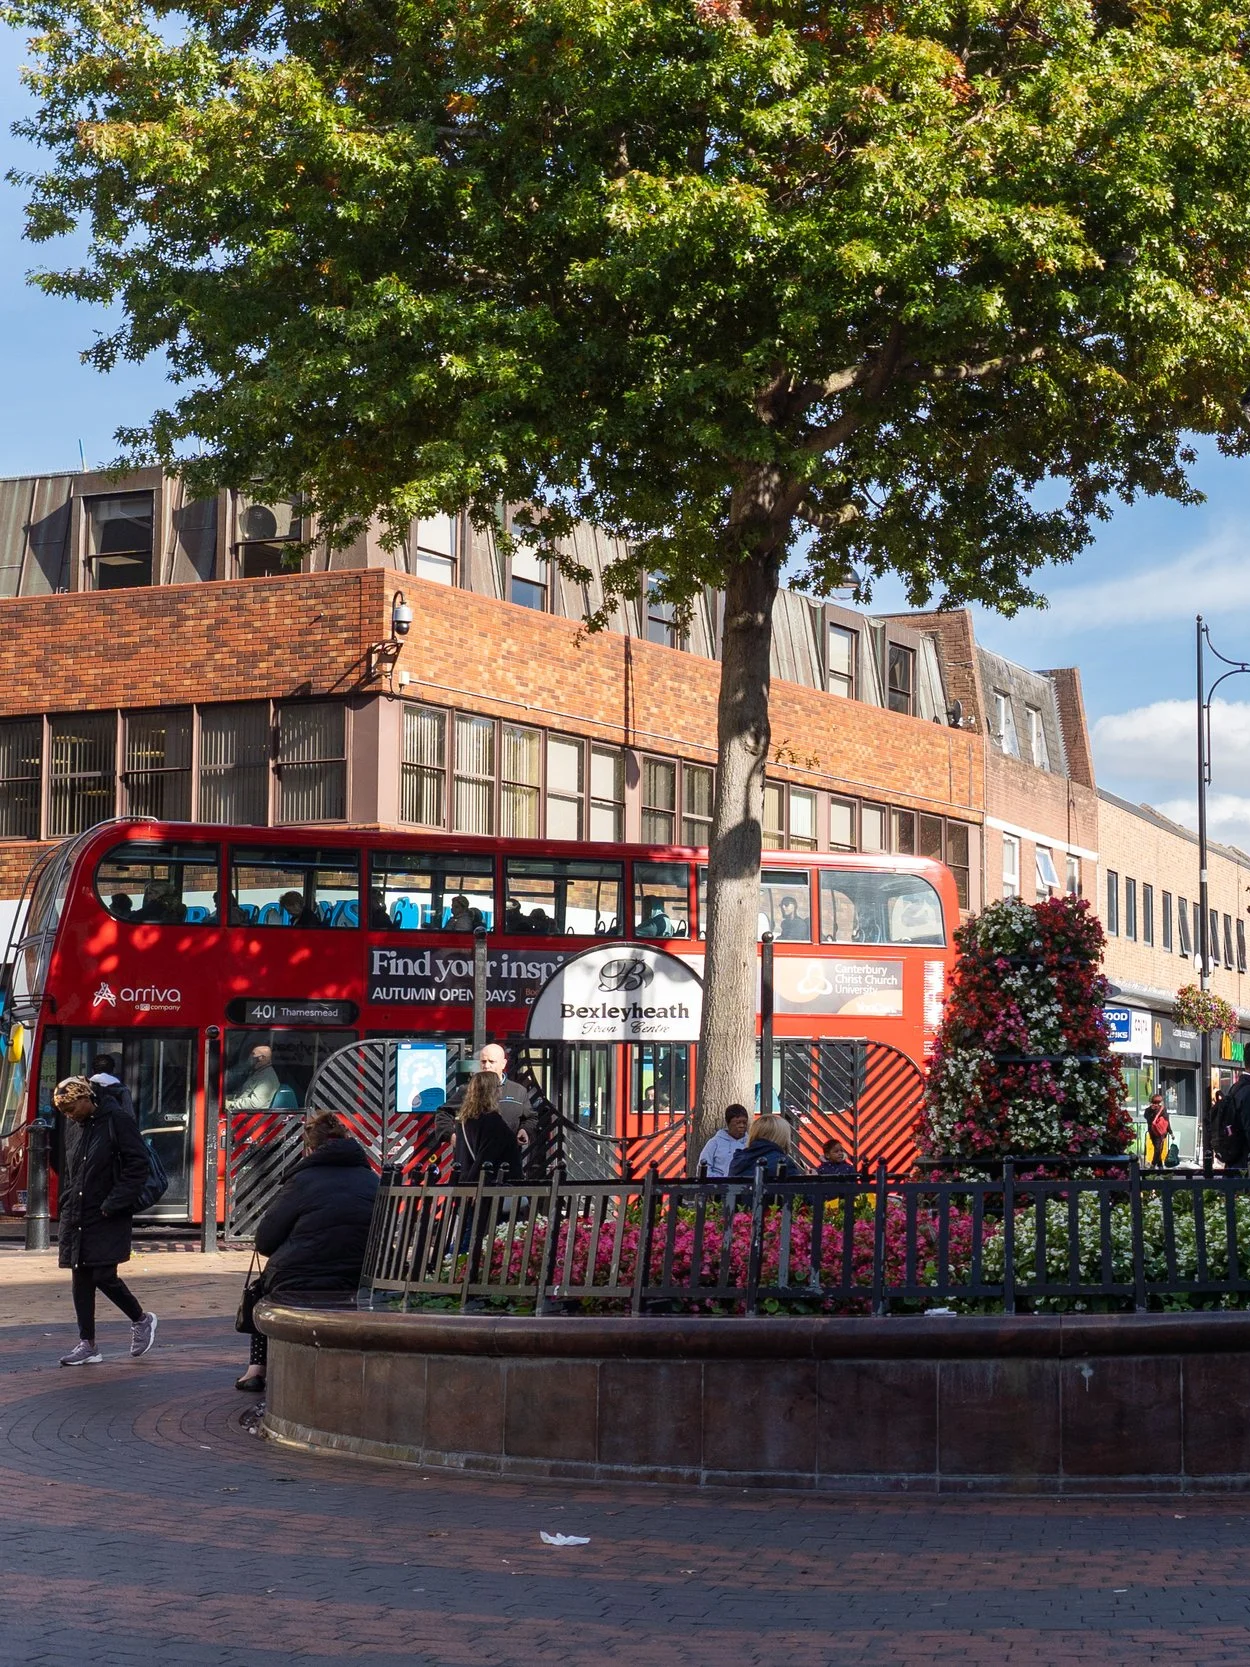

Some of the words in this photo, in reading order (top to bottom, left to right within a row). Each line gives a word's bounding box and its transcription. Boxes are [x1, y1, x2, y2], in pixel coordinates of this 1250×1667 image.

[372, 950, 431, 976] Find
[434, 958, 498, 983] your
[835, 963, 888, 976] Canterbury
[835, 975, 862, 984] Christ
[865, 975, 898, 986] Church
[120, 985, 181, 1002] arriva
[372, 987, 436, 1001] AUTUMN
[835, 985, 878, 995] University
[251, 1006, 276, 1018] 401
[281, 1007, 339, 1017] Thamesmead
[560, 1002, 689, 1022] Bexleyheath
[581, 1021, 618, 1035] Town
[630, 1020, 670, 1034] Centre
